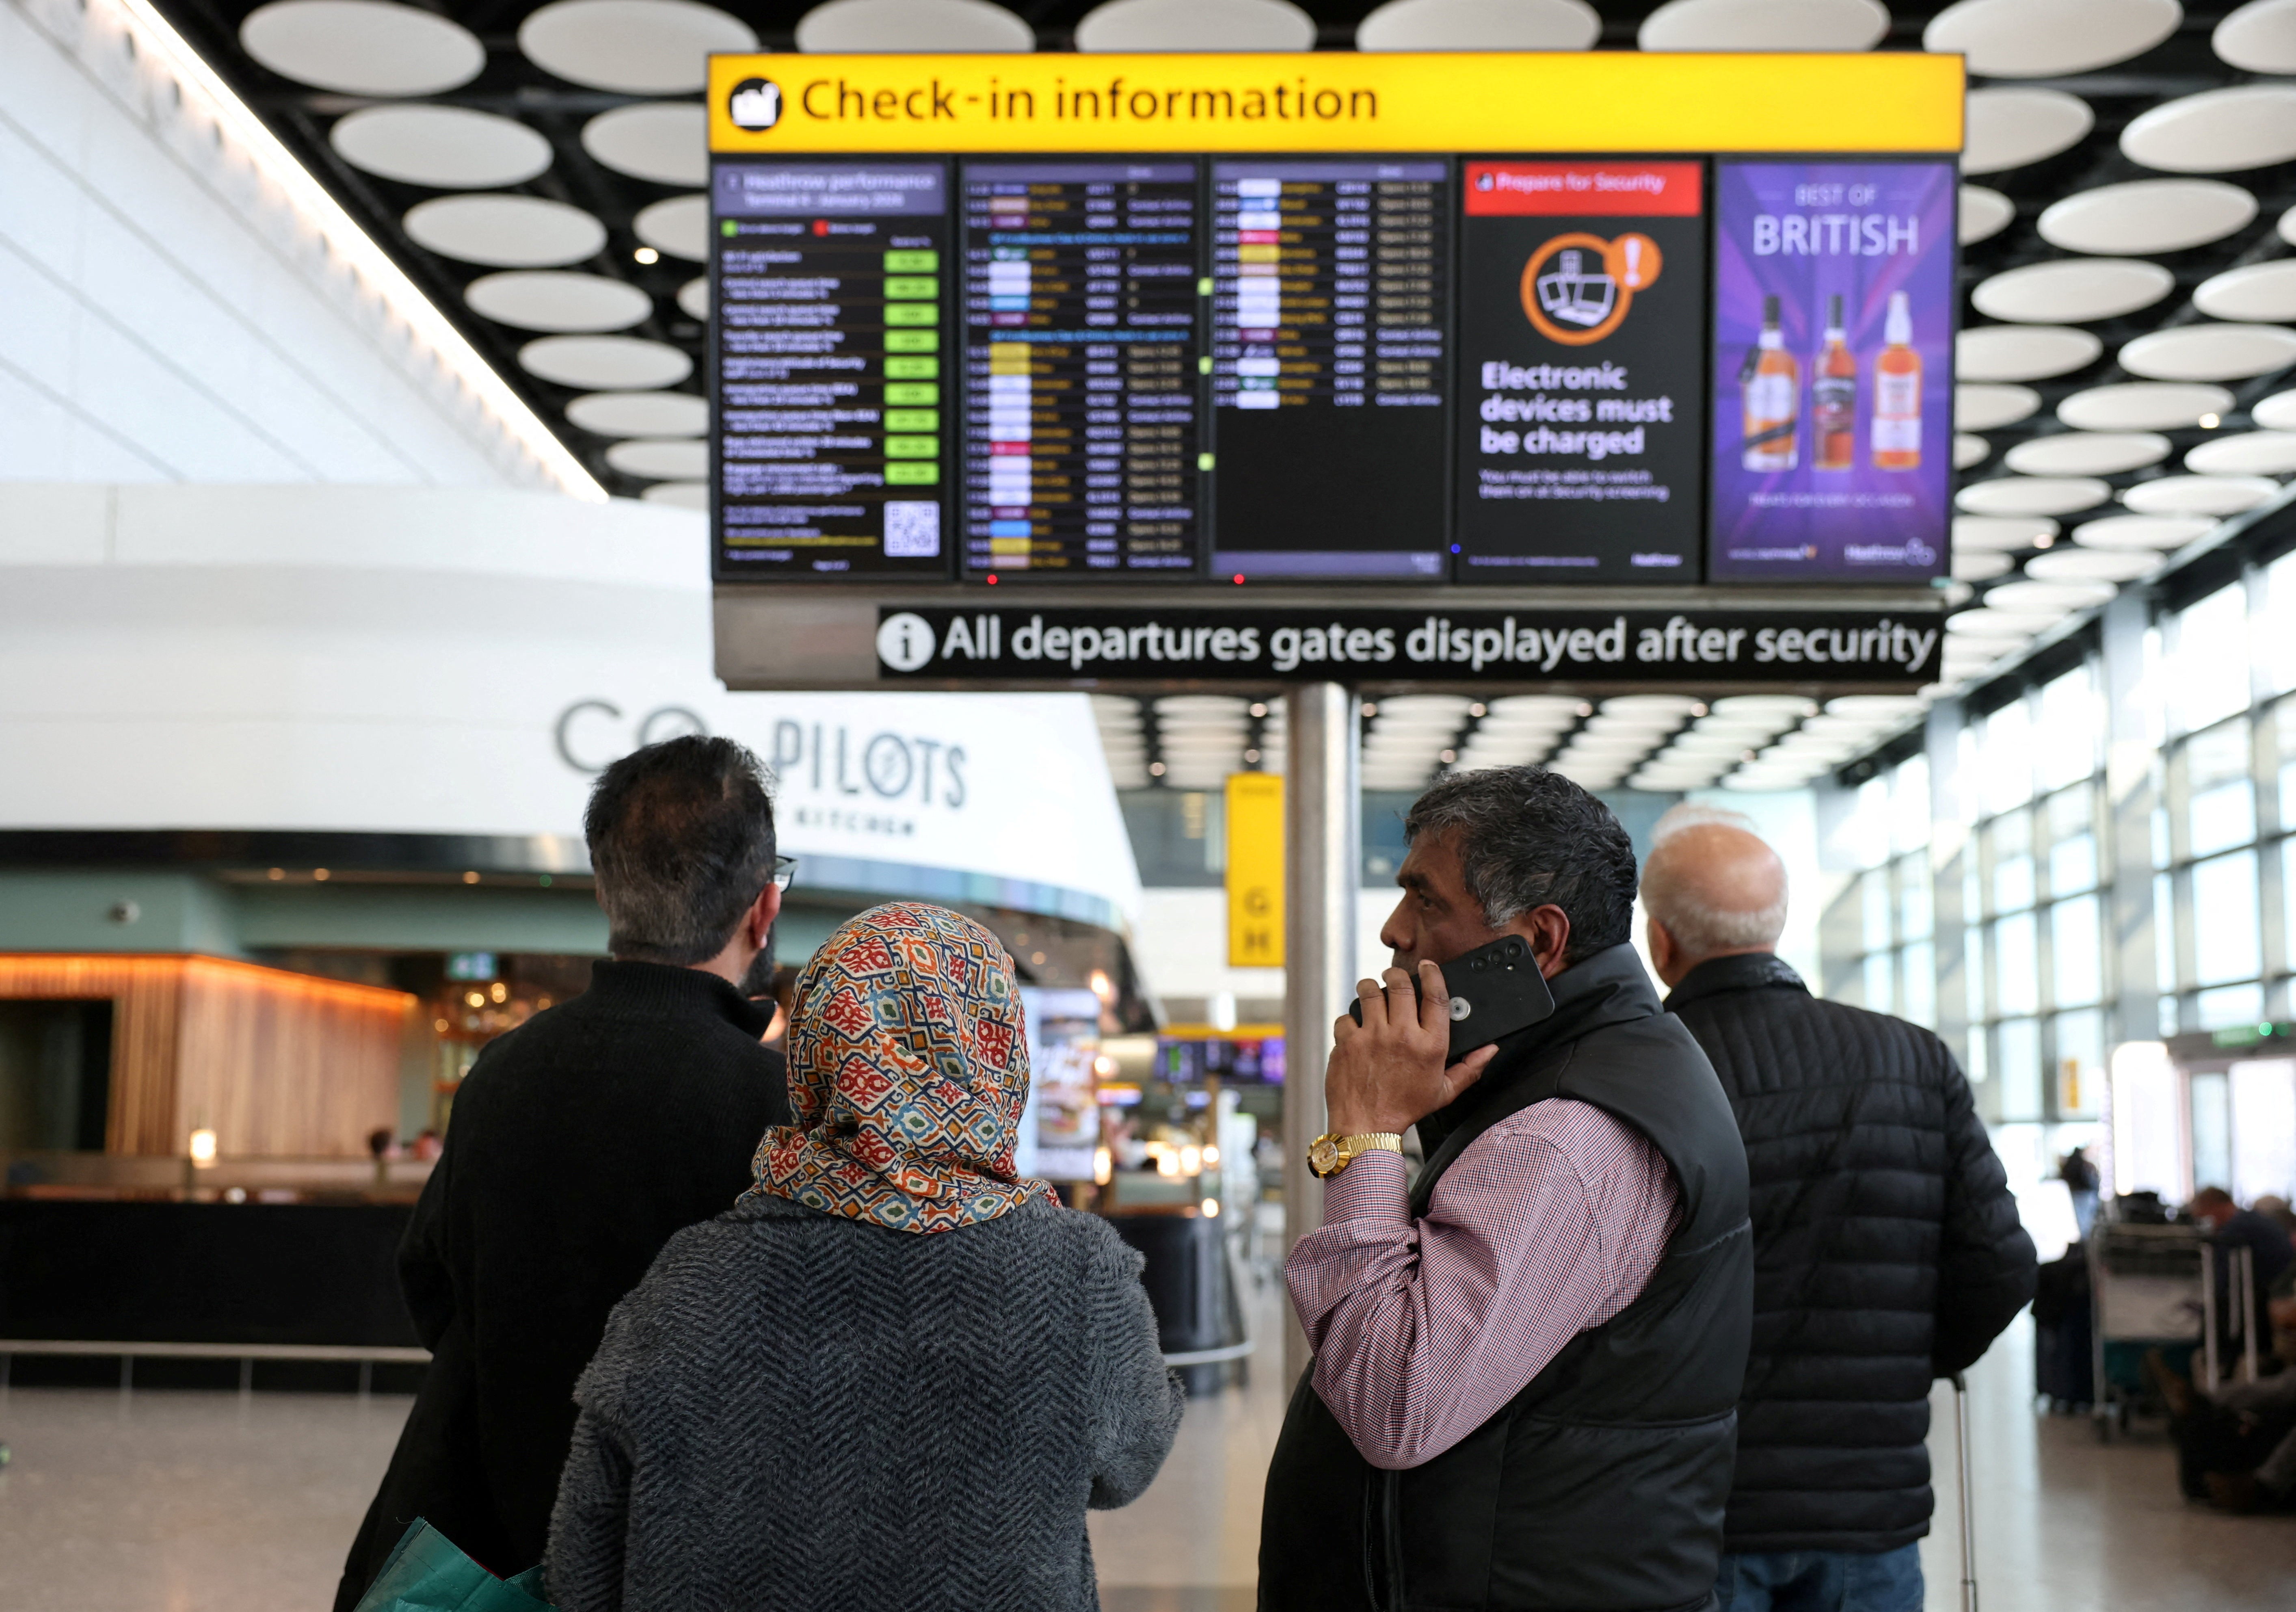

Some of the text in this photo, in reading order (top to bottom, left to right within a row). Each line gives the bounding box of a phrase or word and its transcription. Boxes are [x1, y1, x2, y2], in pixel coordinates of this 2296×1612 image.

[802, 79, 1377, 119] Check-in information
[1496, 173, 1666, 195] Prepare for Security
[1795, 184, 1877, 206] BEST OF
[1753, 214, 1919, 256] BRITISH
[1481, 361, 1628, 390] Electronic
[1480, 393, 1673, 423] devices must
[1481, 425, 1645, 461] be charged
[942, 615, 1000, 660] All
[1011, 615, 1261, 671] departures
[1270, 622, 1396, 672] gates
[1405, 616, 1626, 672] displayed
[1637, 616, 1743, 662] after
[1755, 617, 1937, 673] security
[772, 718, 966, 808] PILOTS
[1243, 886, 1272, 919] G
